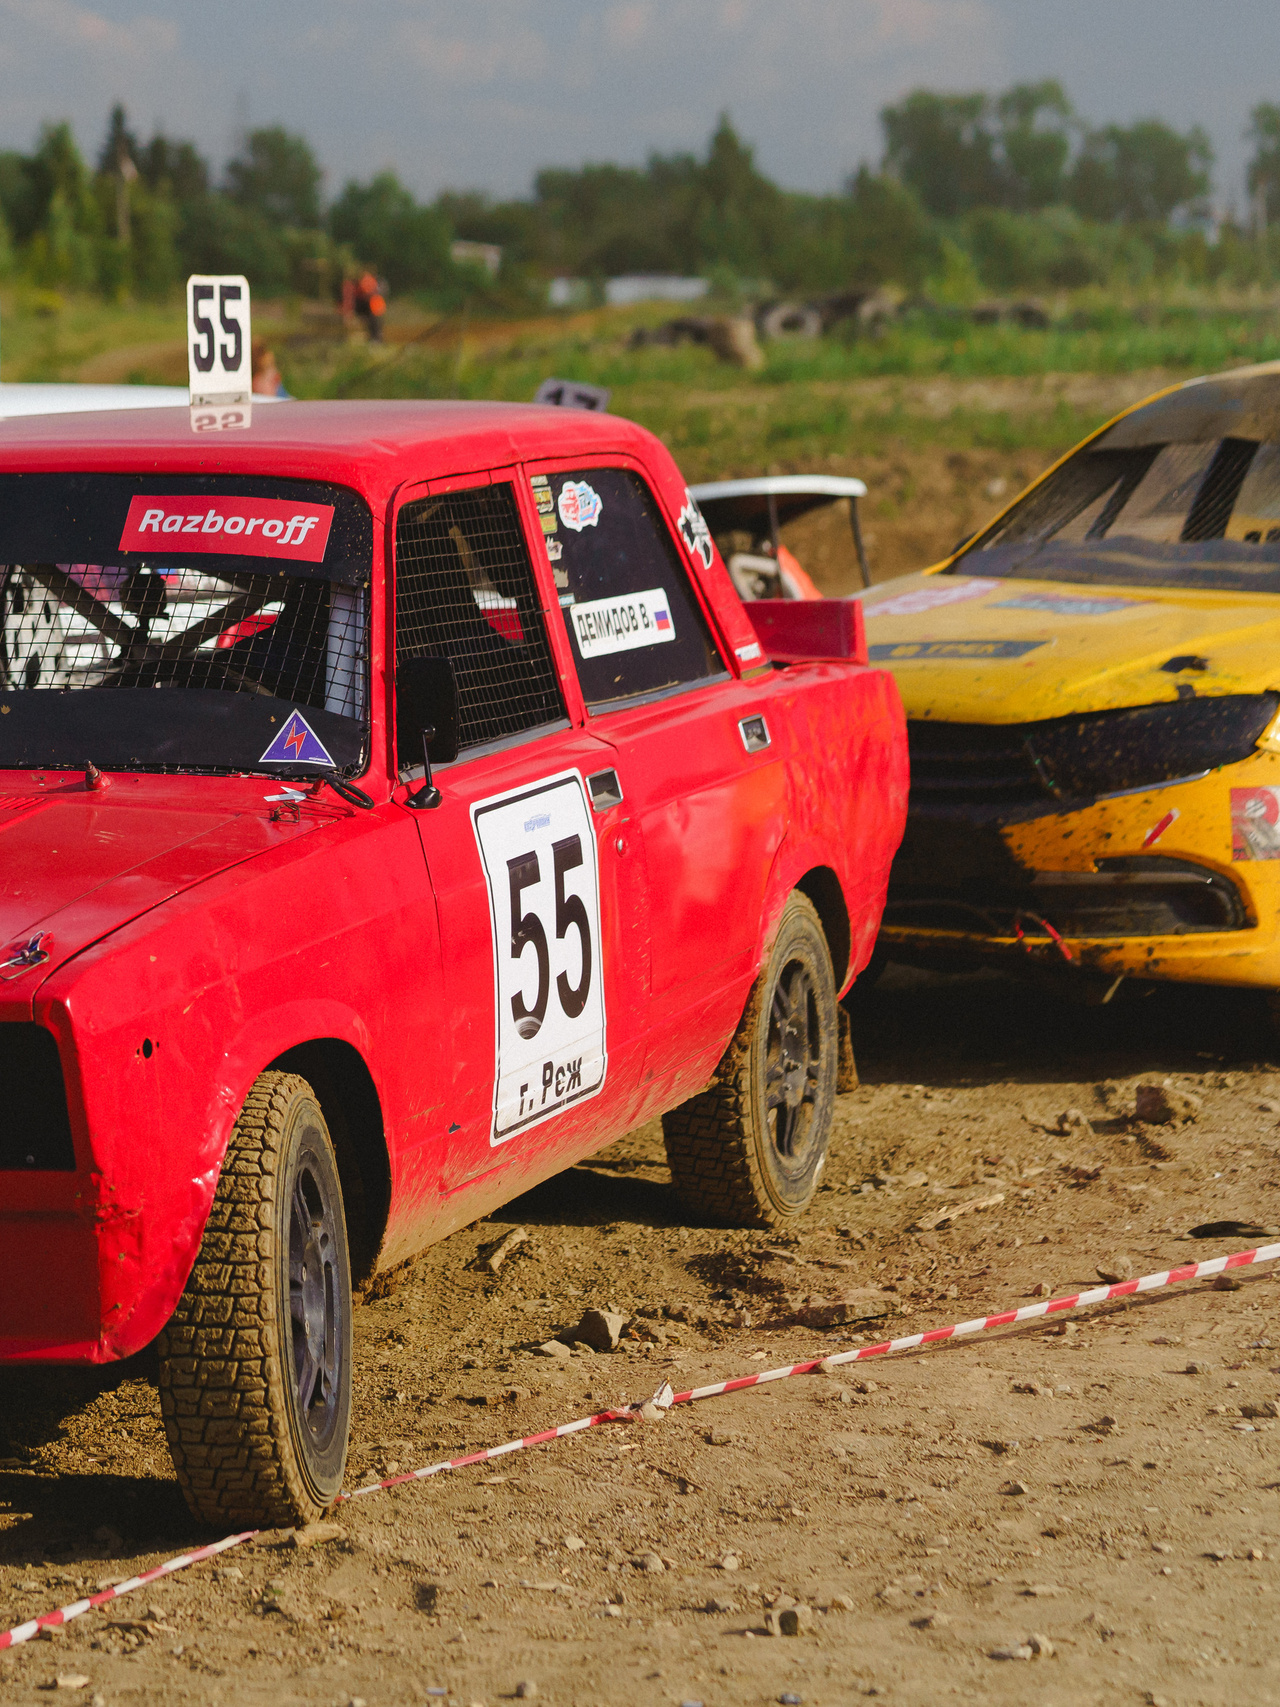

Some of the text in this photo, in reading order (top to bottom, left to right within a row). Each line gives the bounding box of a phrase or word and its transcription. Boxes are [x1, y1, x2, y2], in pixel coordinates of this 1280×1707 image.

[193, 285, 242, 372] 55
[138, 509, 320, 545] Razboroff
[577, 605, 639, 648] ДЕМИДОВ
[506, 834, 592, 1040] 55
[541, 1057, 582, 1105] Реж
